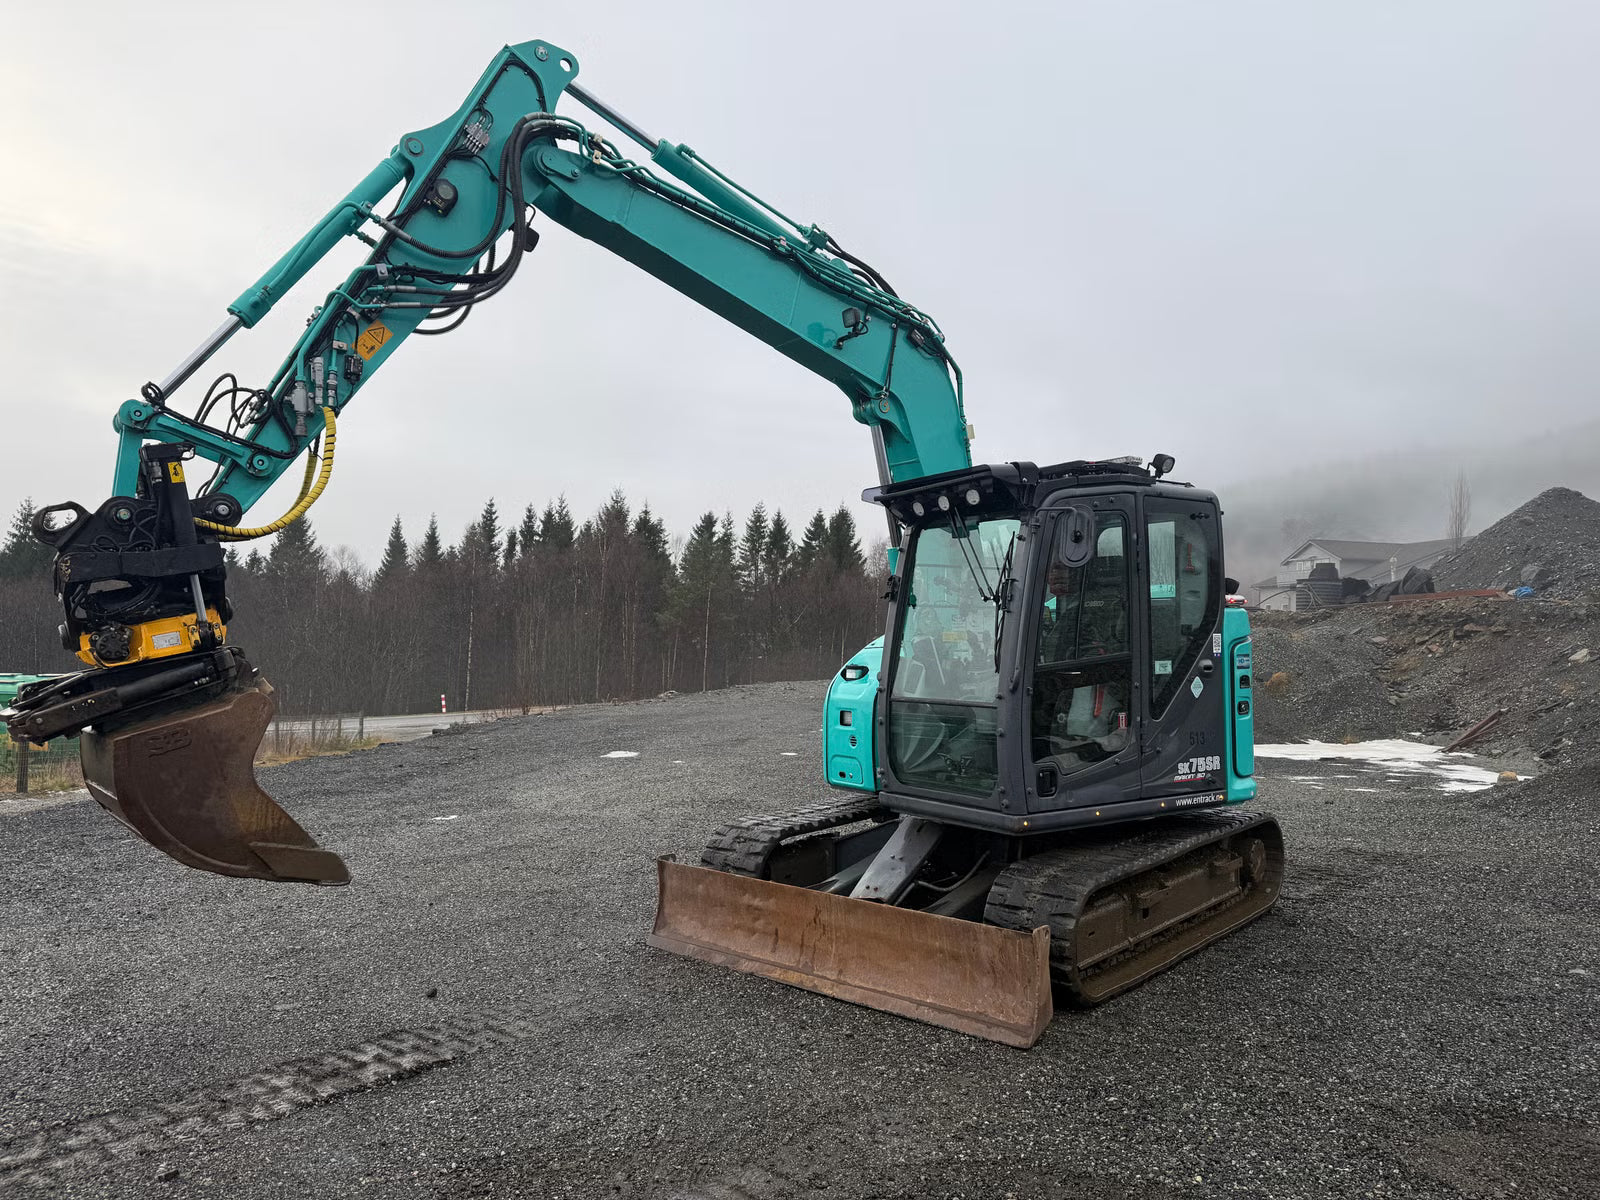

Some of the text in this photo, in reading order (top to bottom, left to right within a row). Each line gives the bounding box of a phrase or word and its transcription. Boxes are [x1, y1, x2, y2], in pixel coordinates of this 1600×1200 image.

[1190, 731, 1205, 745] 513
[1178, 755, 1220, 774] SK75SR
[1175, 793, 1224, 807] www.entrack.n
